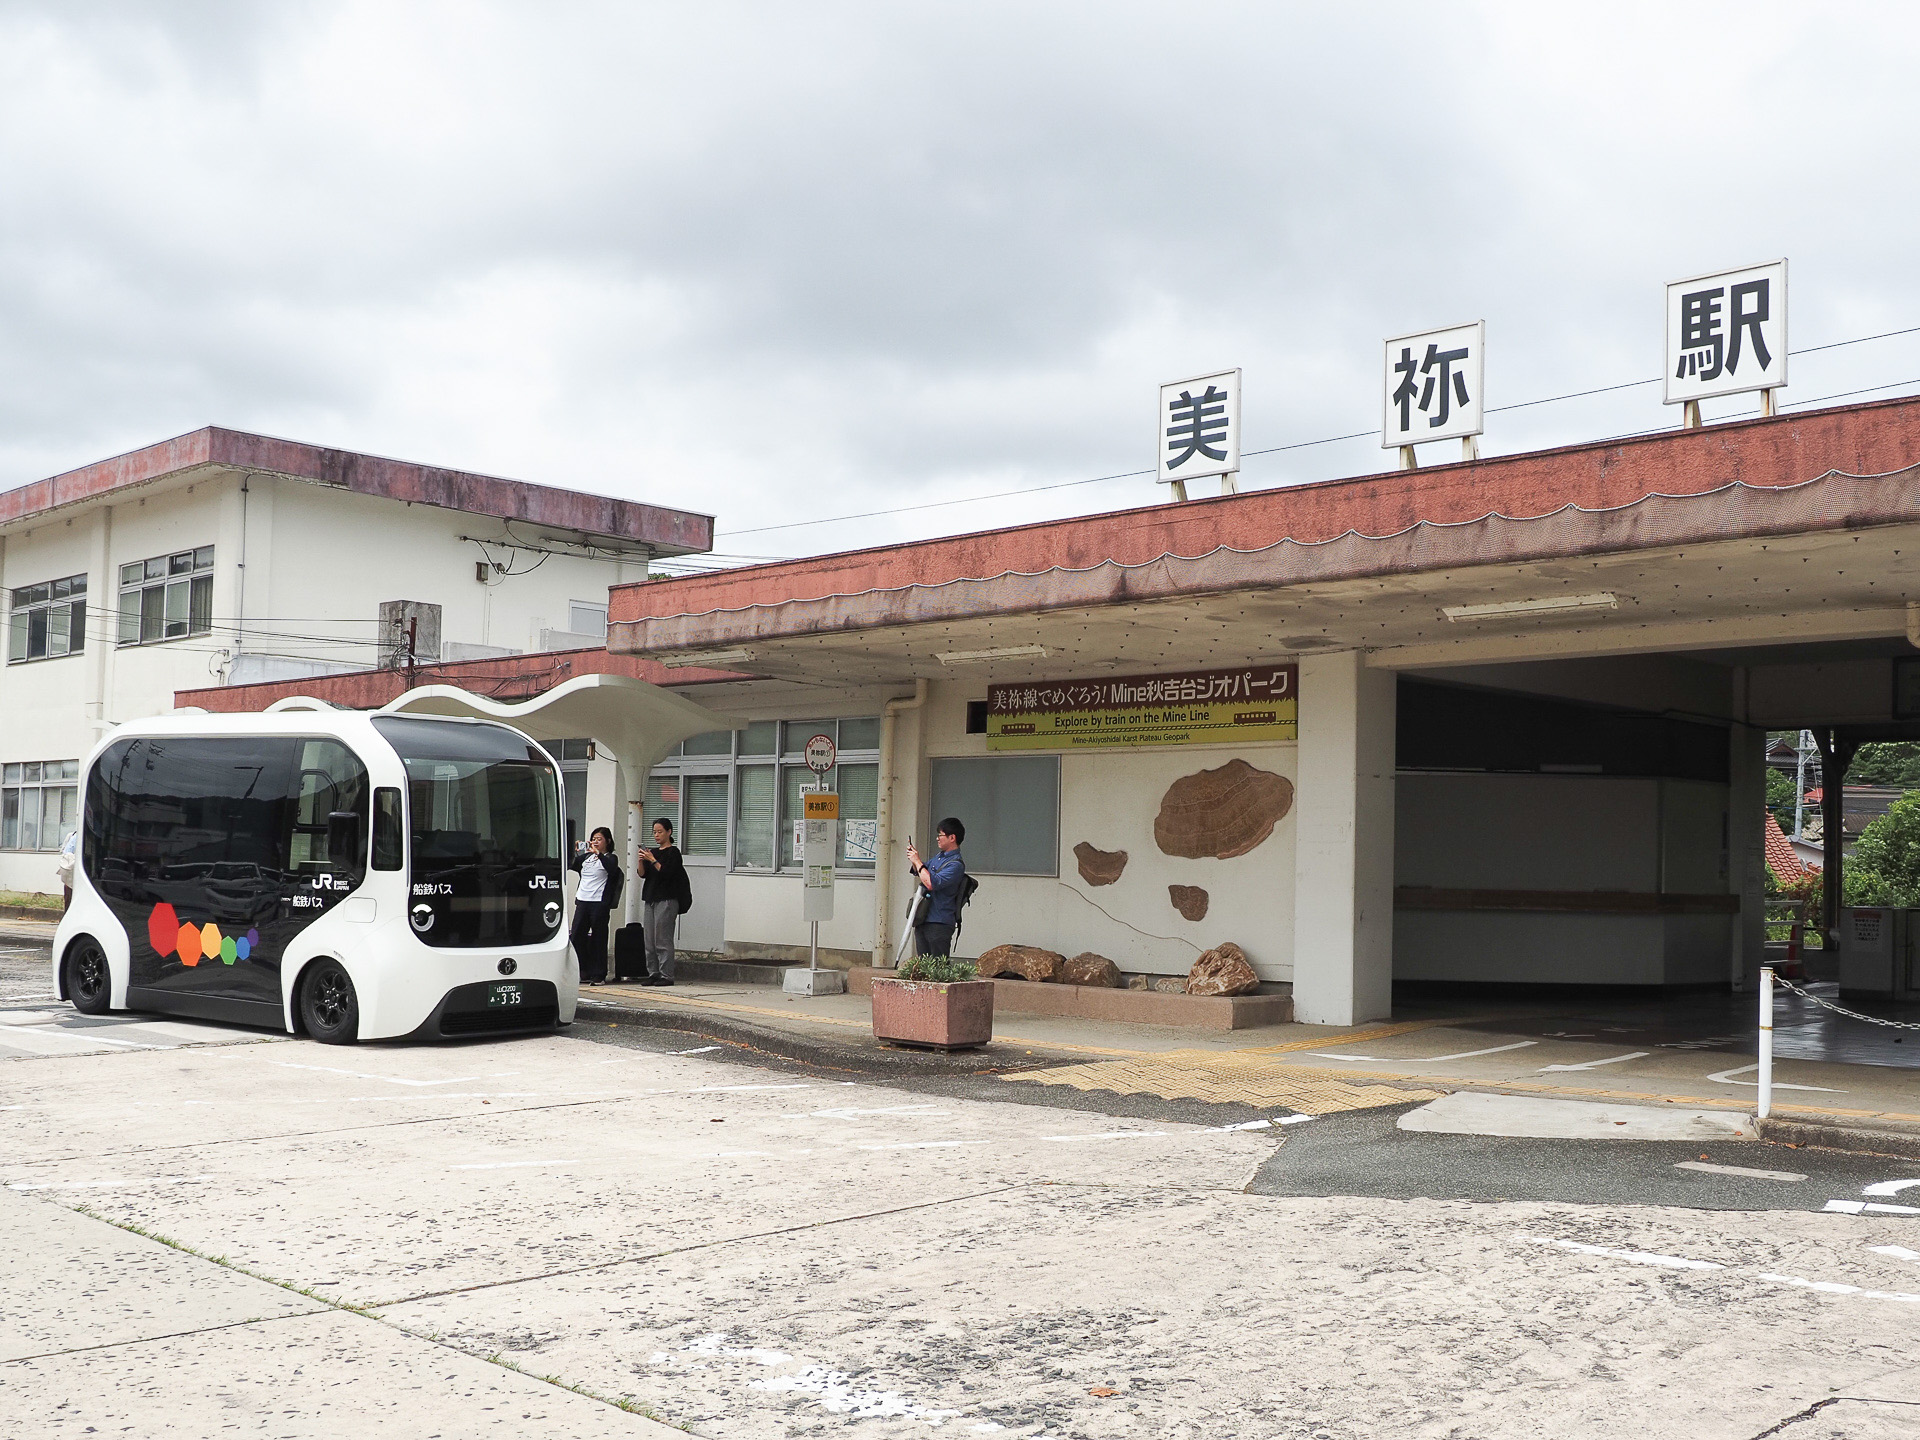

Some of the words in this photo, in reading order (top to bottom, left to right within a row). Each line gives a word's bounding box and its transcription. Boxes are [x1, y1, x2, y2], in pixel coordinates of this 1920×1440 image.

[1166, 385, 1229, 470] 美
[1393, 343, 1471, 432] 祢
[1675, 278, 1772, 382] 駅
[1054, 716, 1088, 729] Explore
[1091, 715, 1102, 727] by
[1105, 714, 1126, 725] train
[1129, 715, 1141, 724] on
[1144, 712, 1160, 723] the
[1162, 711, 1187, 722] Mine
[1189, 710, 1210, 721] Line
[1122, 734, 1138, 743] Karst
[1139, 734, 1162, 743] Plateau
[1163, 733, 1190, 743] Geopark
[312, 873, 332, 890] JR
[528, 875, 546, 889] JR
[413, 883, 453, 895] 船鉄バス
[292, 895, 323, 909] 船鉄バス
